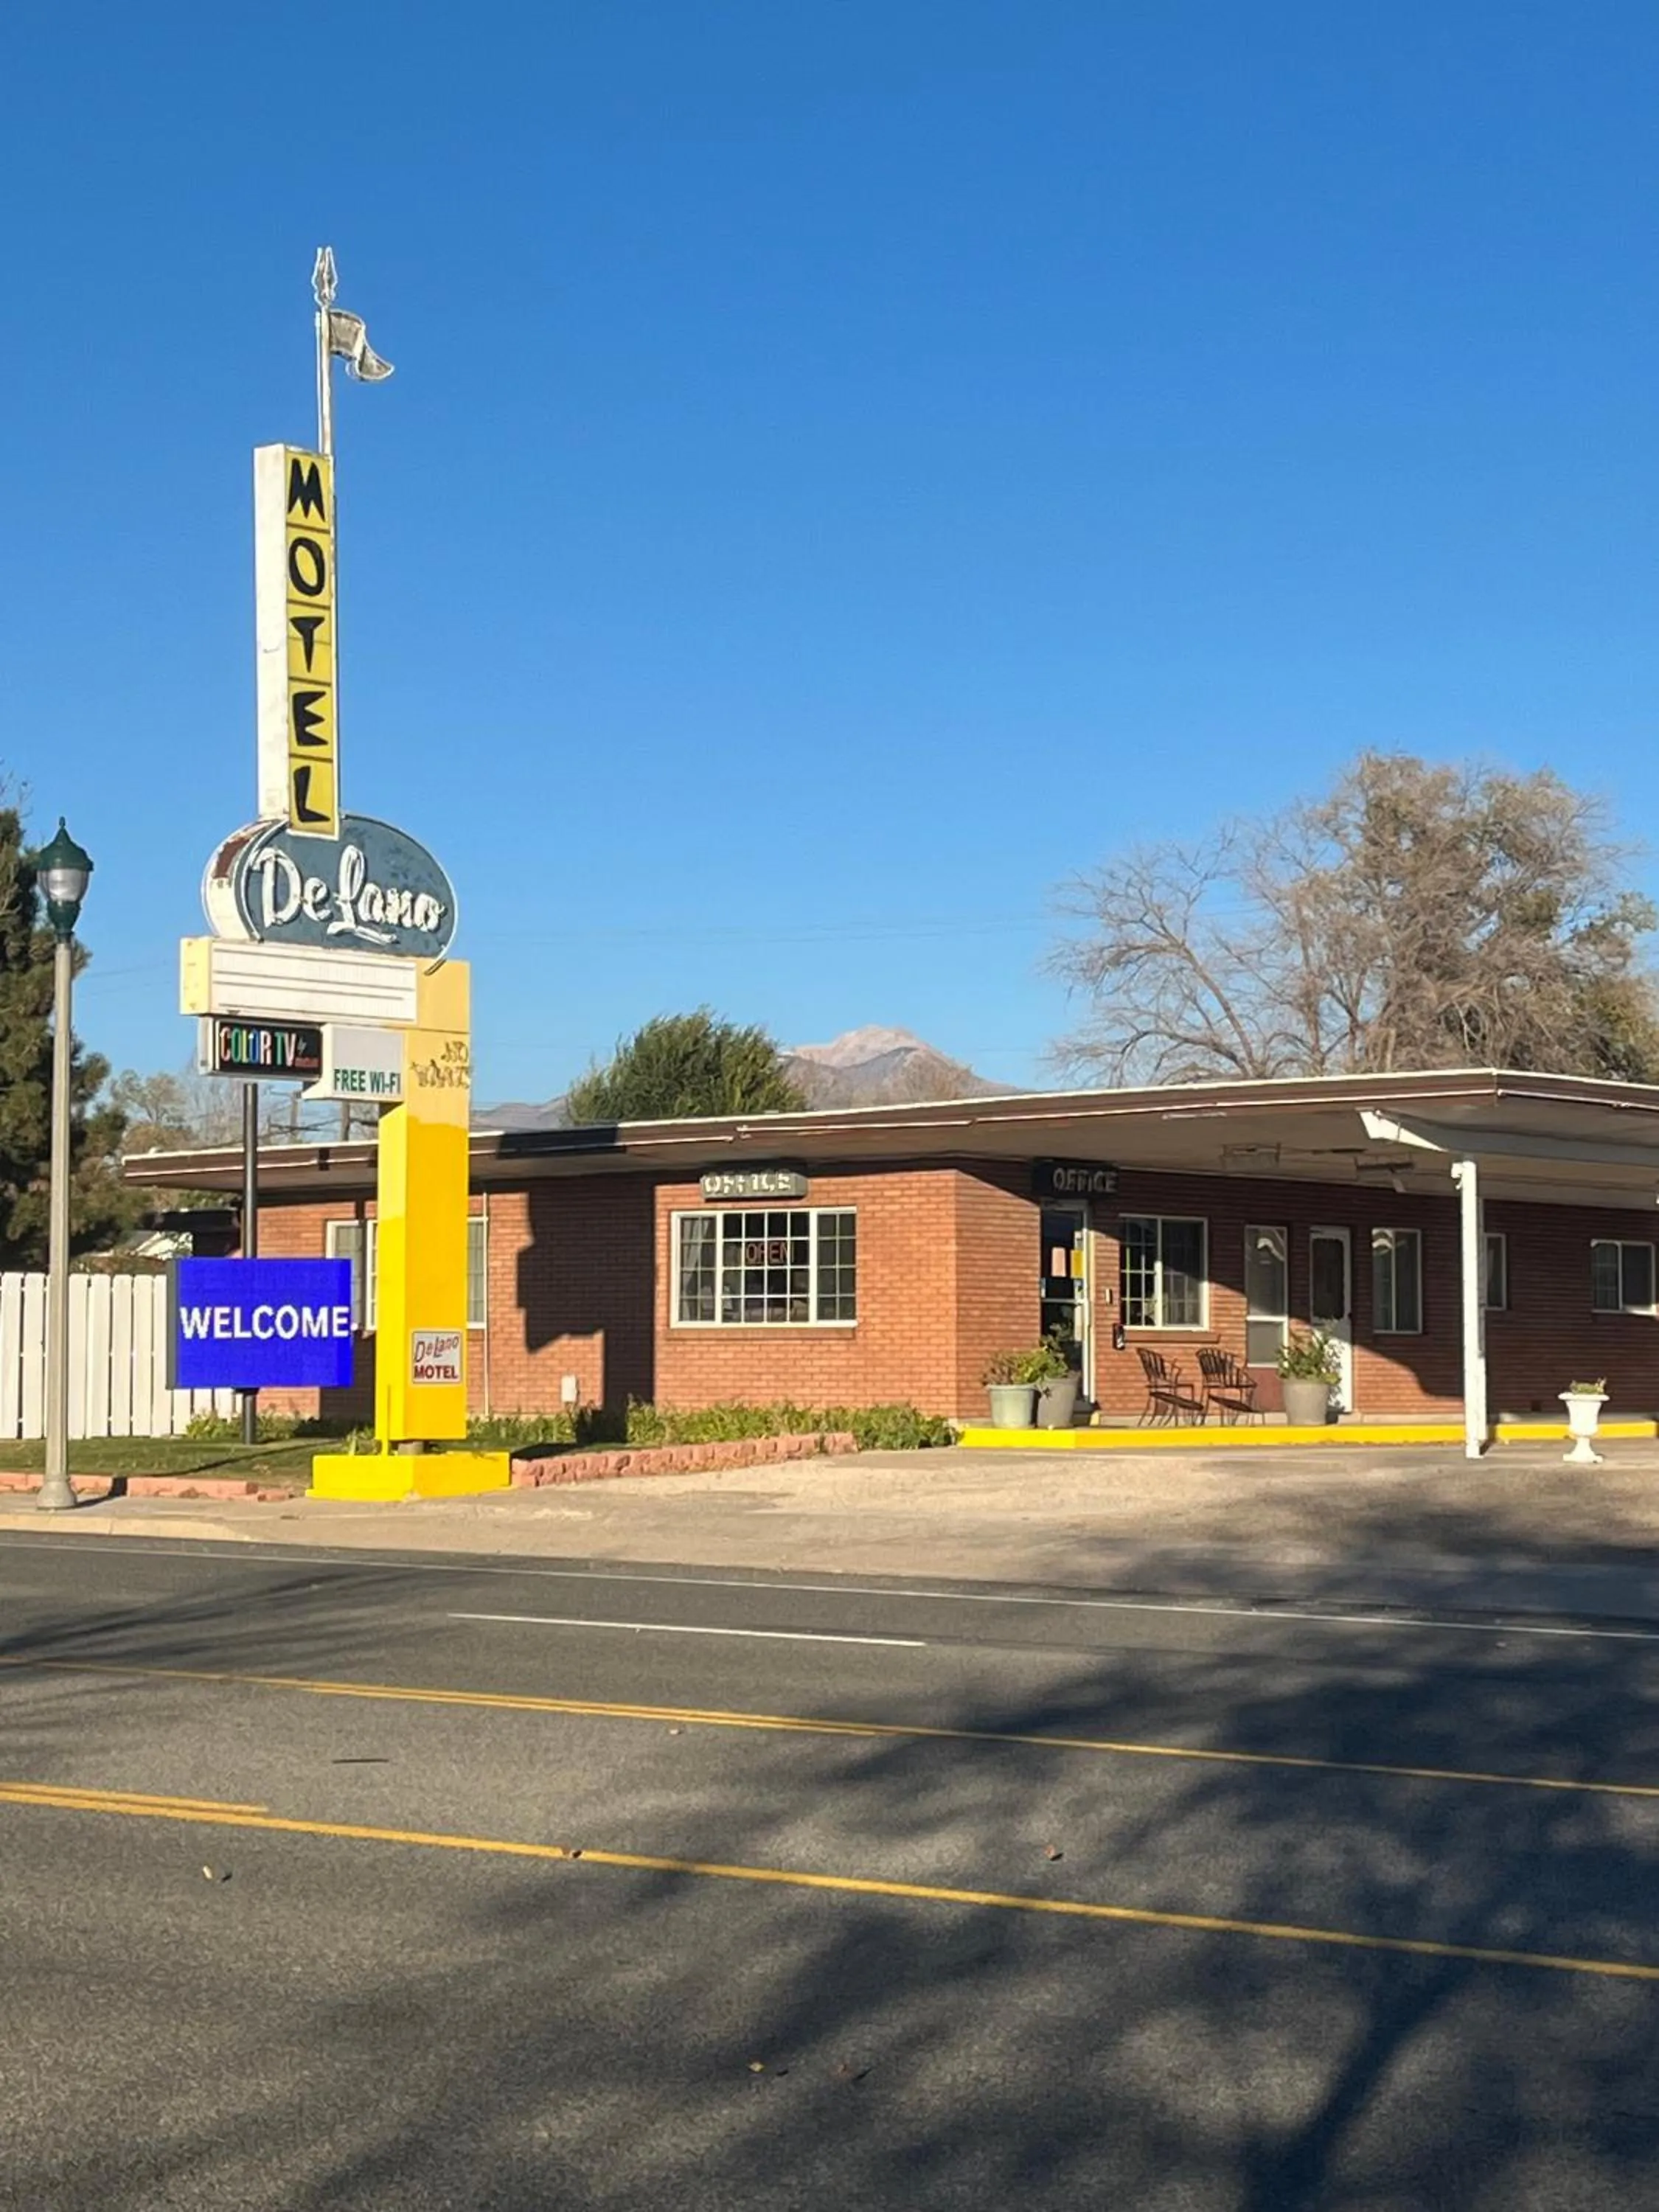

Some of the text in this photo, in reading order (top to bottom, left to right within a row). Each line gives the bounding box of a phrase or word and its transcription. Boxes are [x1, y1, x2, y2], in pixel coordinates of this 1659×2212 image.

[288, 458, 331, 824] MOTEL
[220, 1026, 296, 1067] COLOR TV
[334, 1068, 366, 1091] FREE
[369, 1071, 401, 1094] WI-FI
[1053, 1167, 1118, 1192] OFFICE
[745, 1242, 794, 1264] OPEN
[180, 1305, 349, 1339] WELCOME
[414, 1365, 458, 1379] MOTEL
